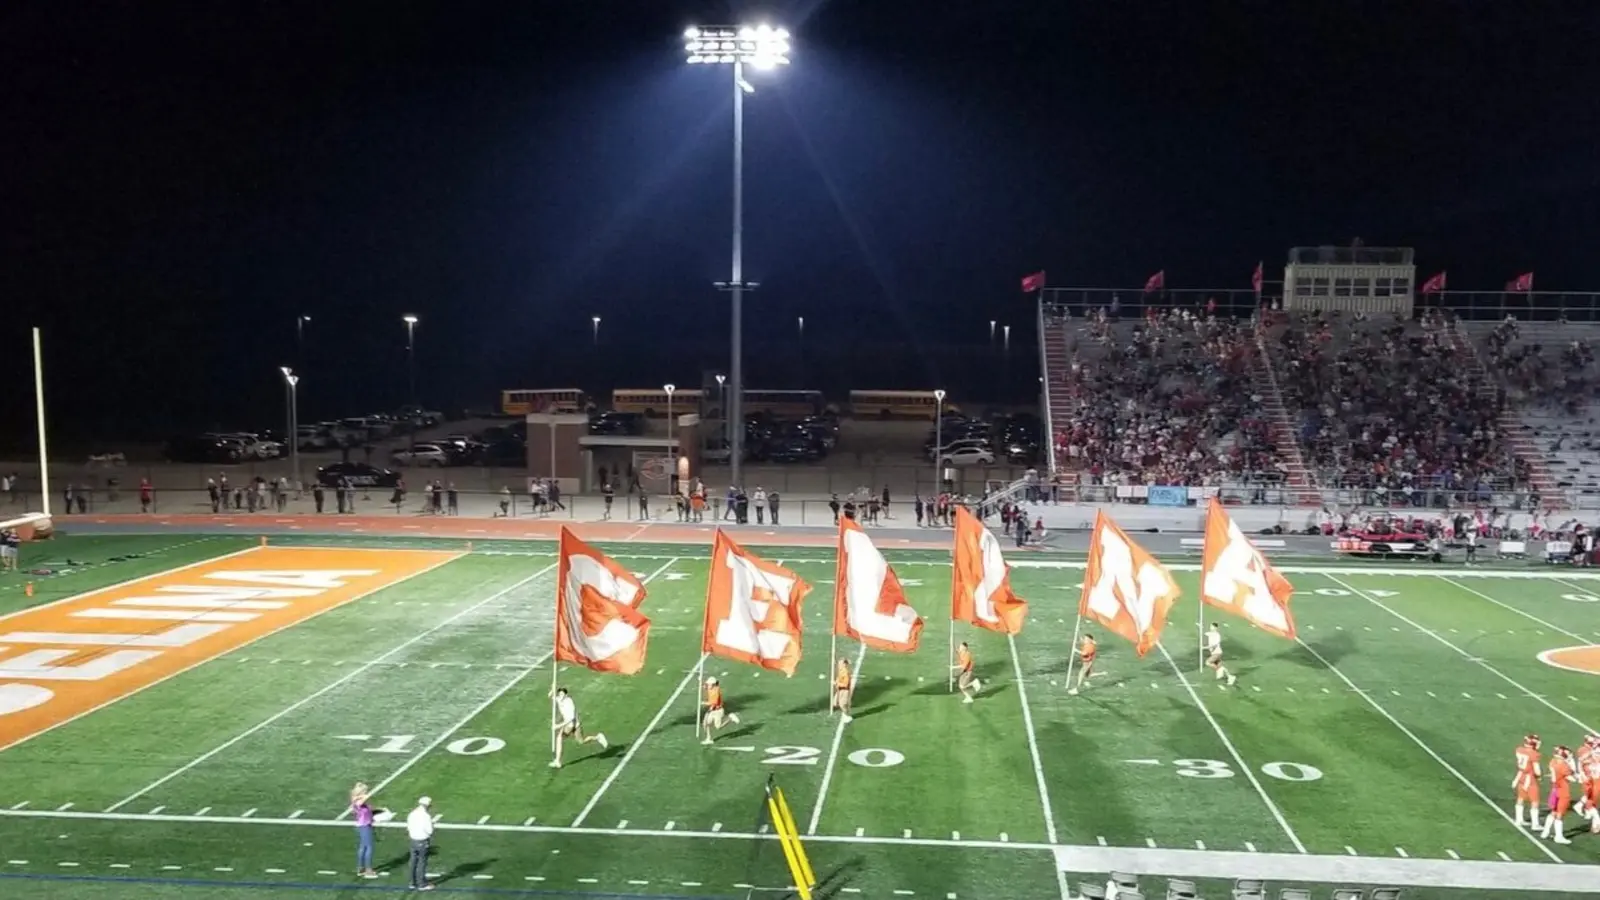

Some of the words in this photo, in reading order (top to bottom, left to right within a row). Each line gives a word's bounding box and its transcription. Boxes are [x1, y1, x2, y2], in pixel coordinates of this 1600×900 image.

[716, 550, 797, 659] E
[844, 528, 919, 643] L
[1204, 518, 1289, 633] A
